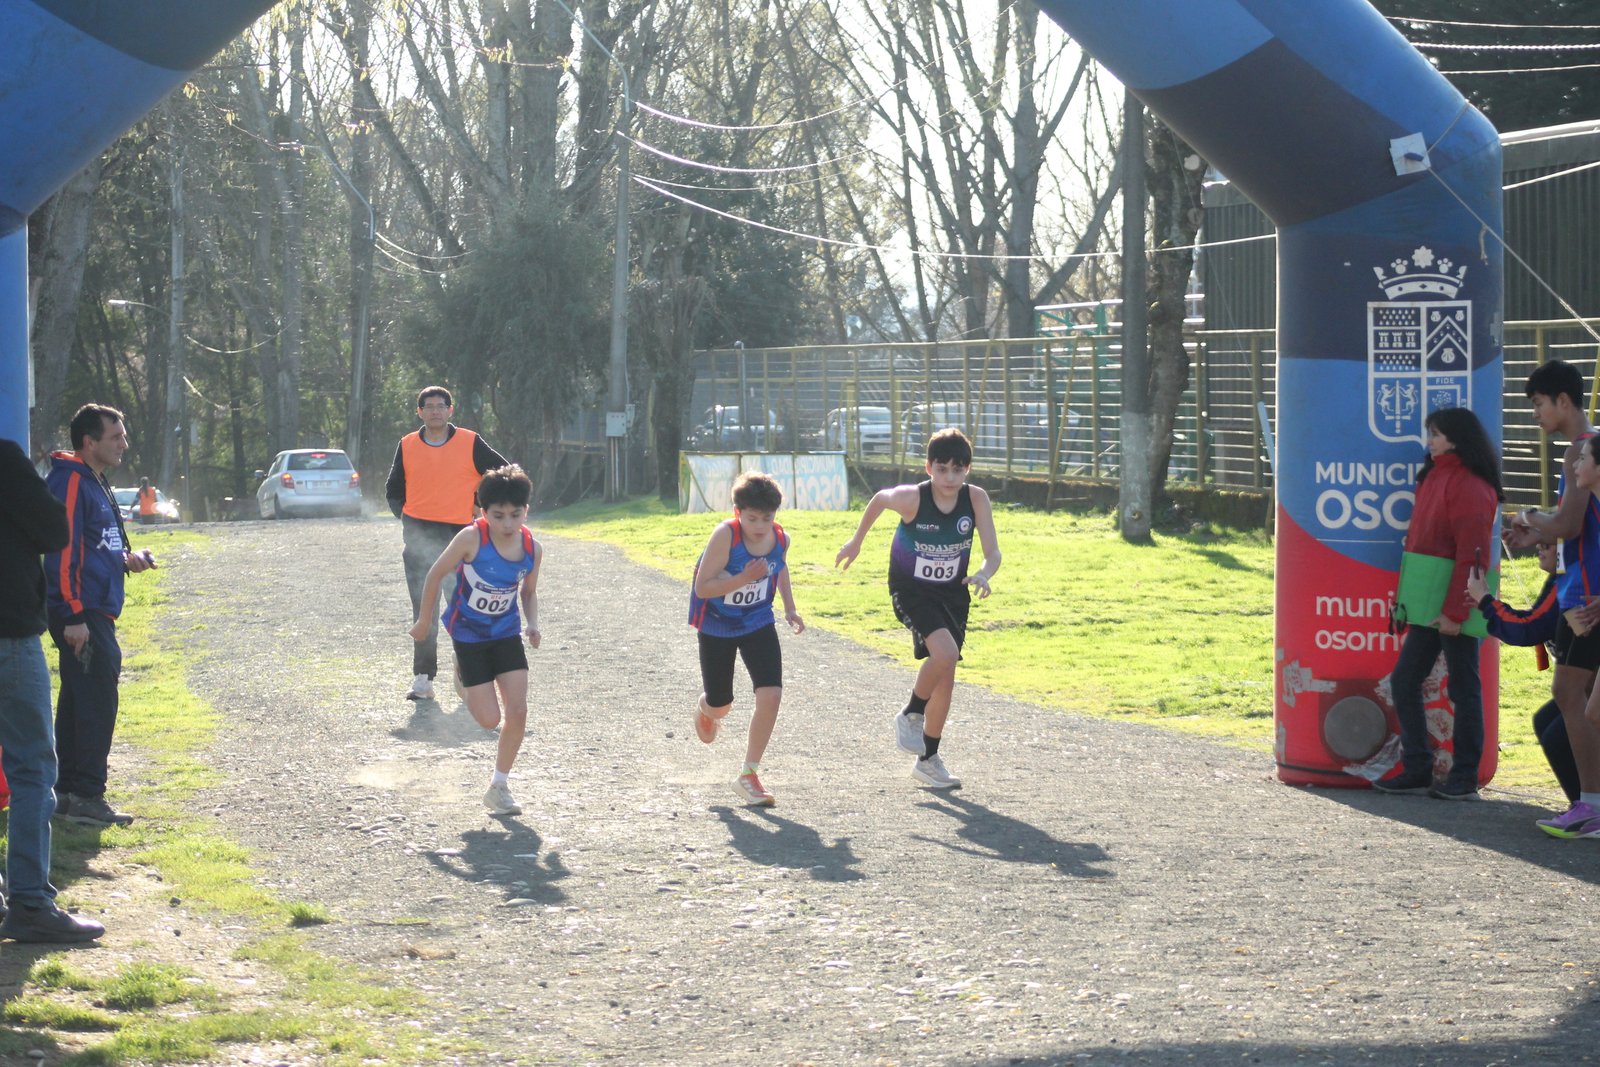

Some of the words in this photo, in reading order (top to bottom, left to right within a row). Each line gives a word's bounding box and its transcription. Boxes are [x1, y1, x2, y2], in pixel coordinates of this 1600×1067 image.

[922, 565, 954, 579] 003
[732, 587, 761, 604] 001
[475, 597, 509, 612] 002
